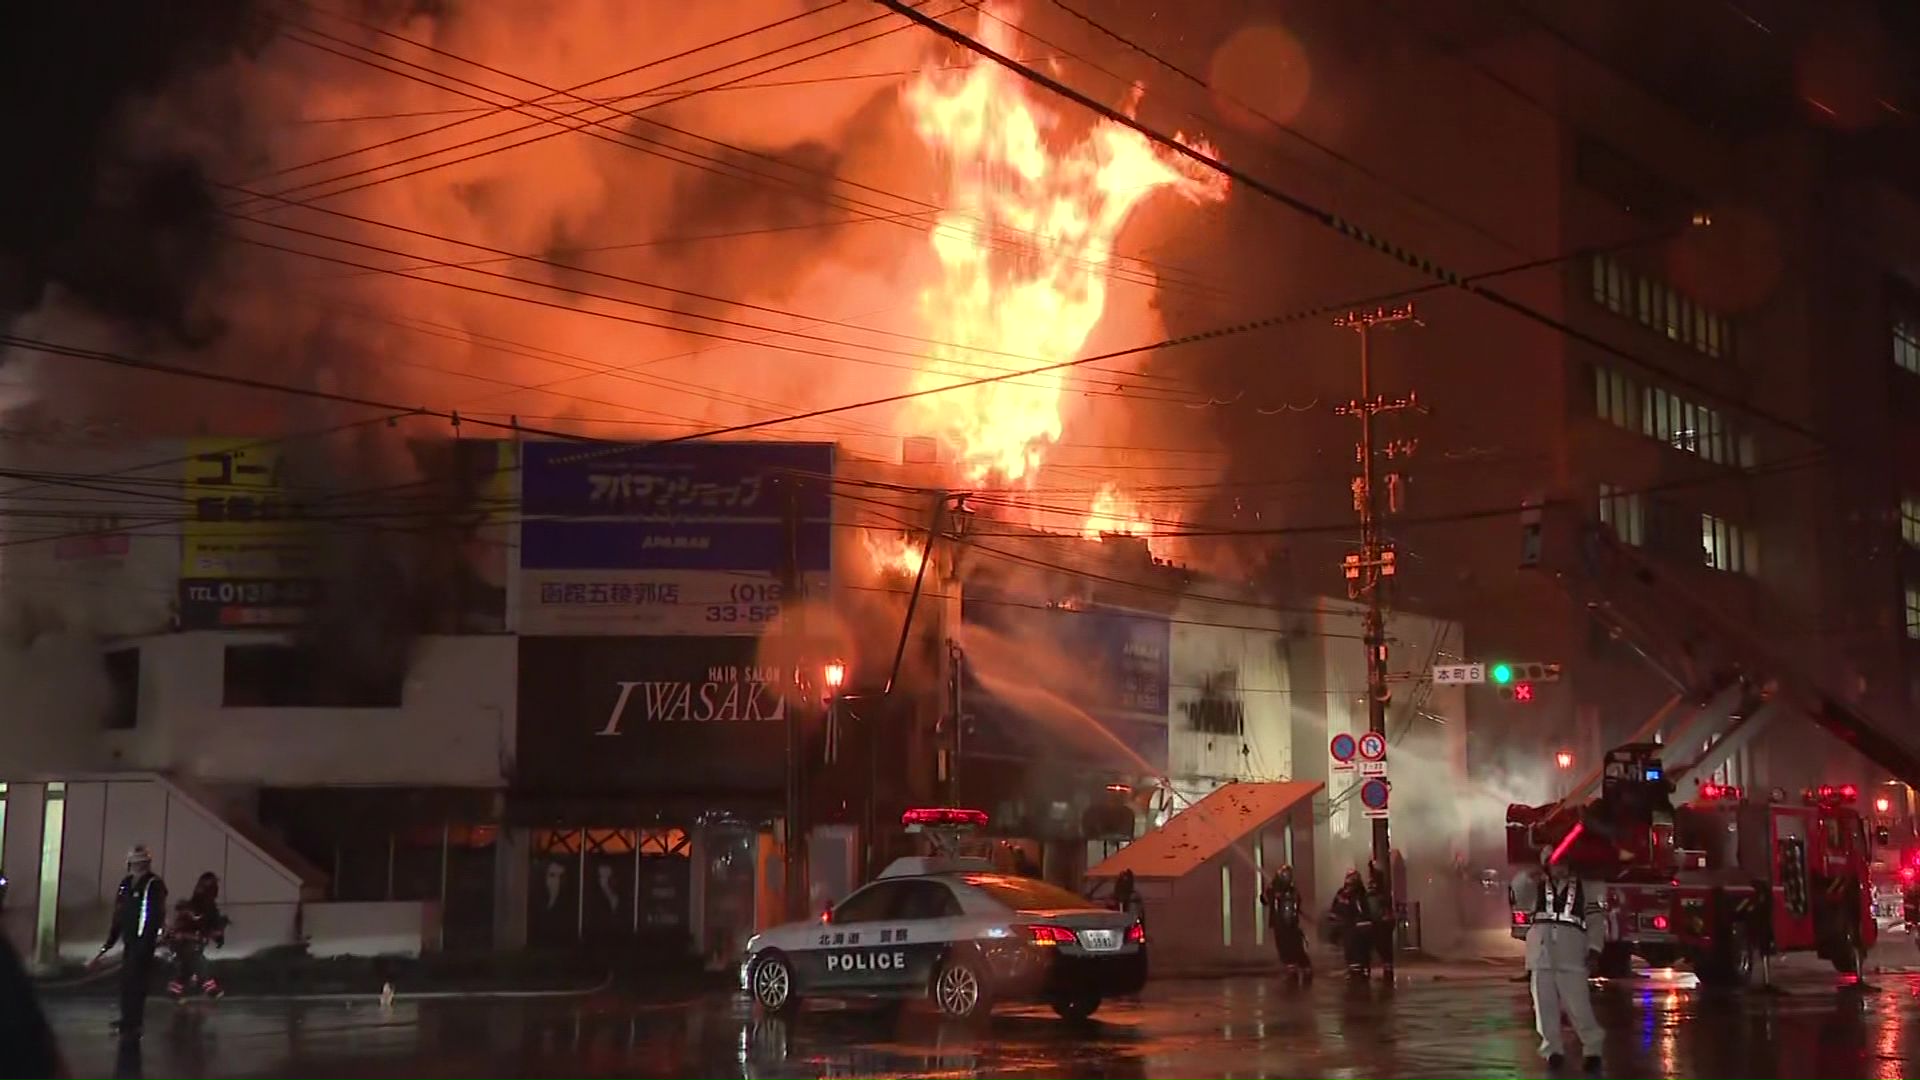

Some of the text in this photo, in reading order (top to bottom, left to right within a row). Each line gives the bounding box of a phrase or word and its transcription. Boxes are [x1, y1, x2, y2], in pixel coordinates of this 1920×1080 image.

[541, 582, 680, 604] 函館五稜郭店
[708, 665, 781, 683] HAIR SALON
[818, 932, 860, 946] 北海道
[827, 952, 905, 971] POLICE
